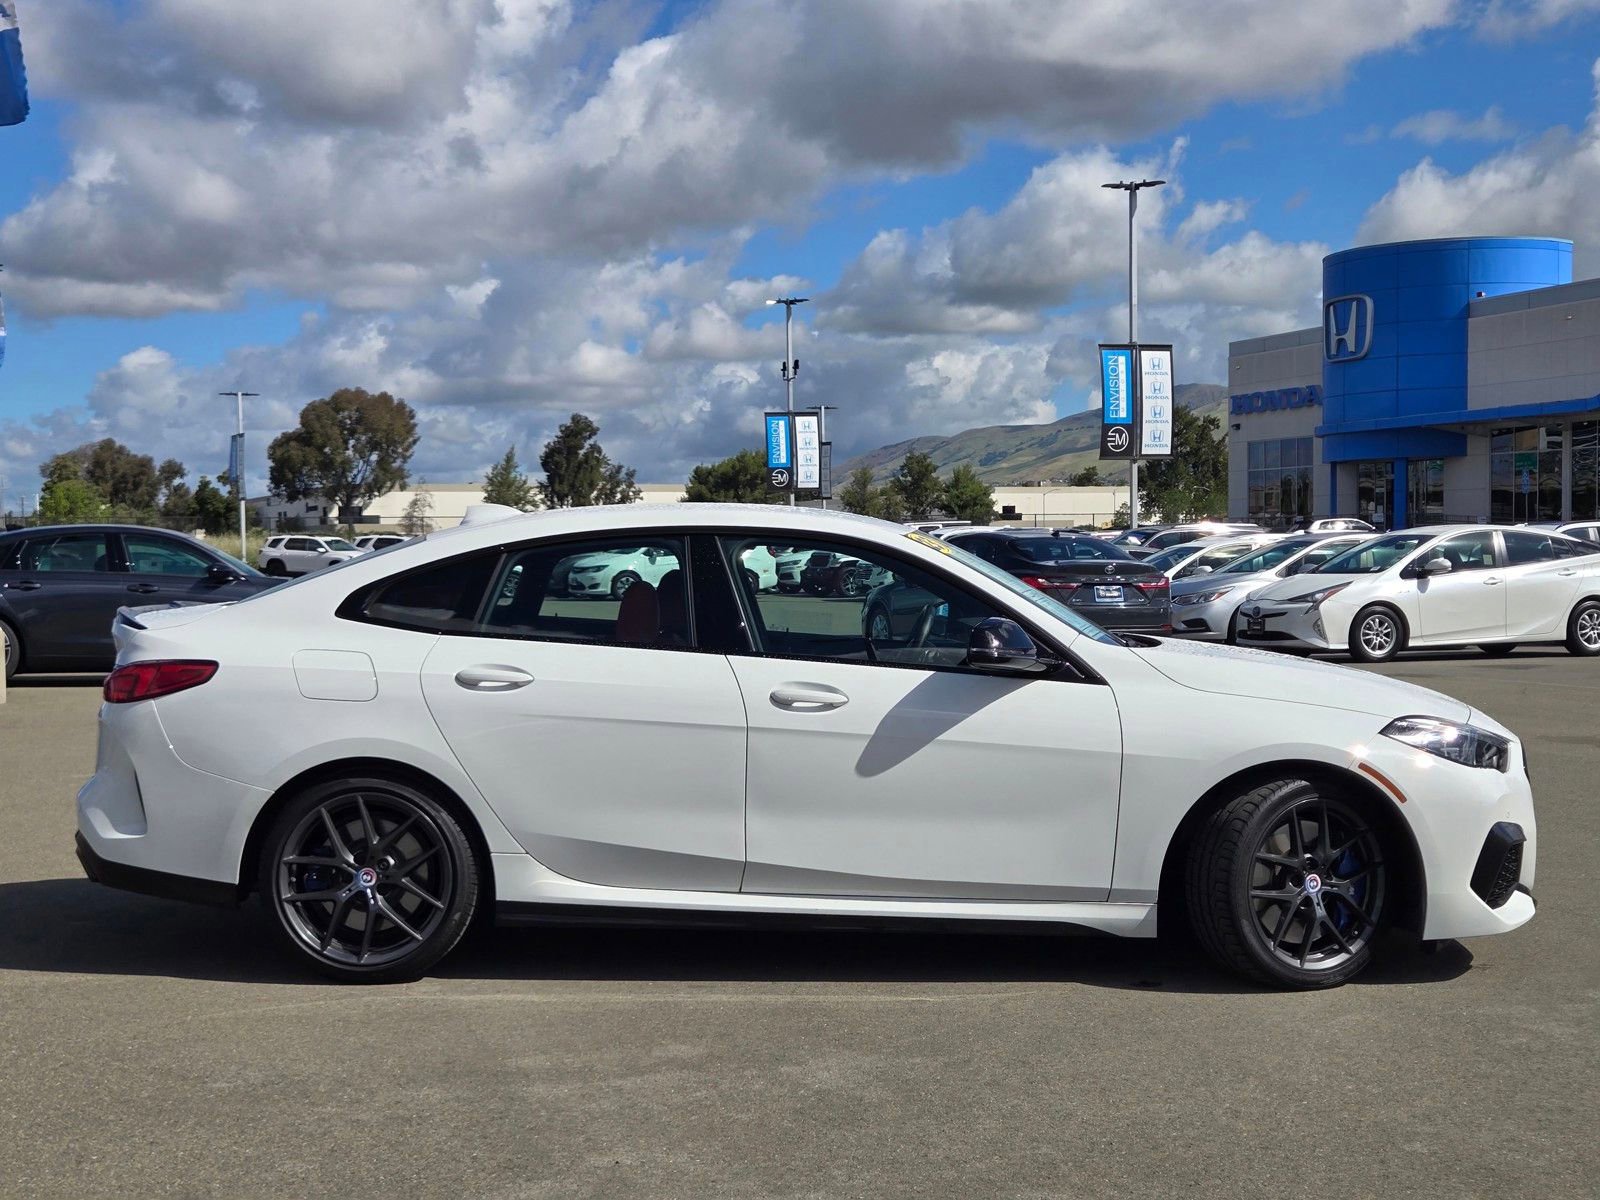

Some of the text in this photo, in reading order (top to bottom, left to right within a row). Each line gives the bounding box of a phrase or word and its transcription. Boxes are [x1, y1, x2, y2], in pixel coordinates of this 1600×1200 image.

[1108, 355, 1119, 418] ENVISION
[1231, 385, 1322, 415] HONDA
[771, 420, 780, 464] ENVISION
